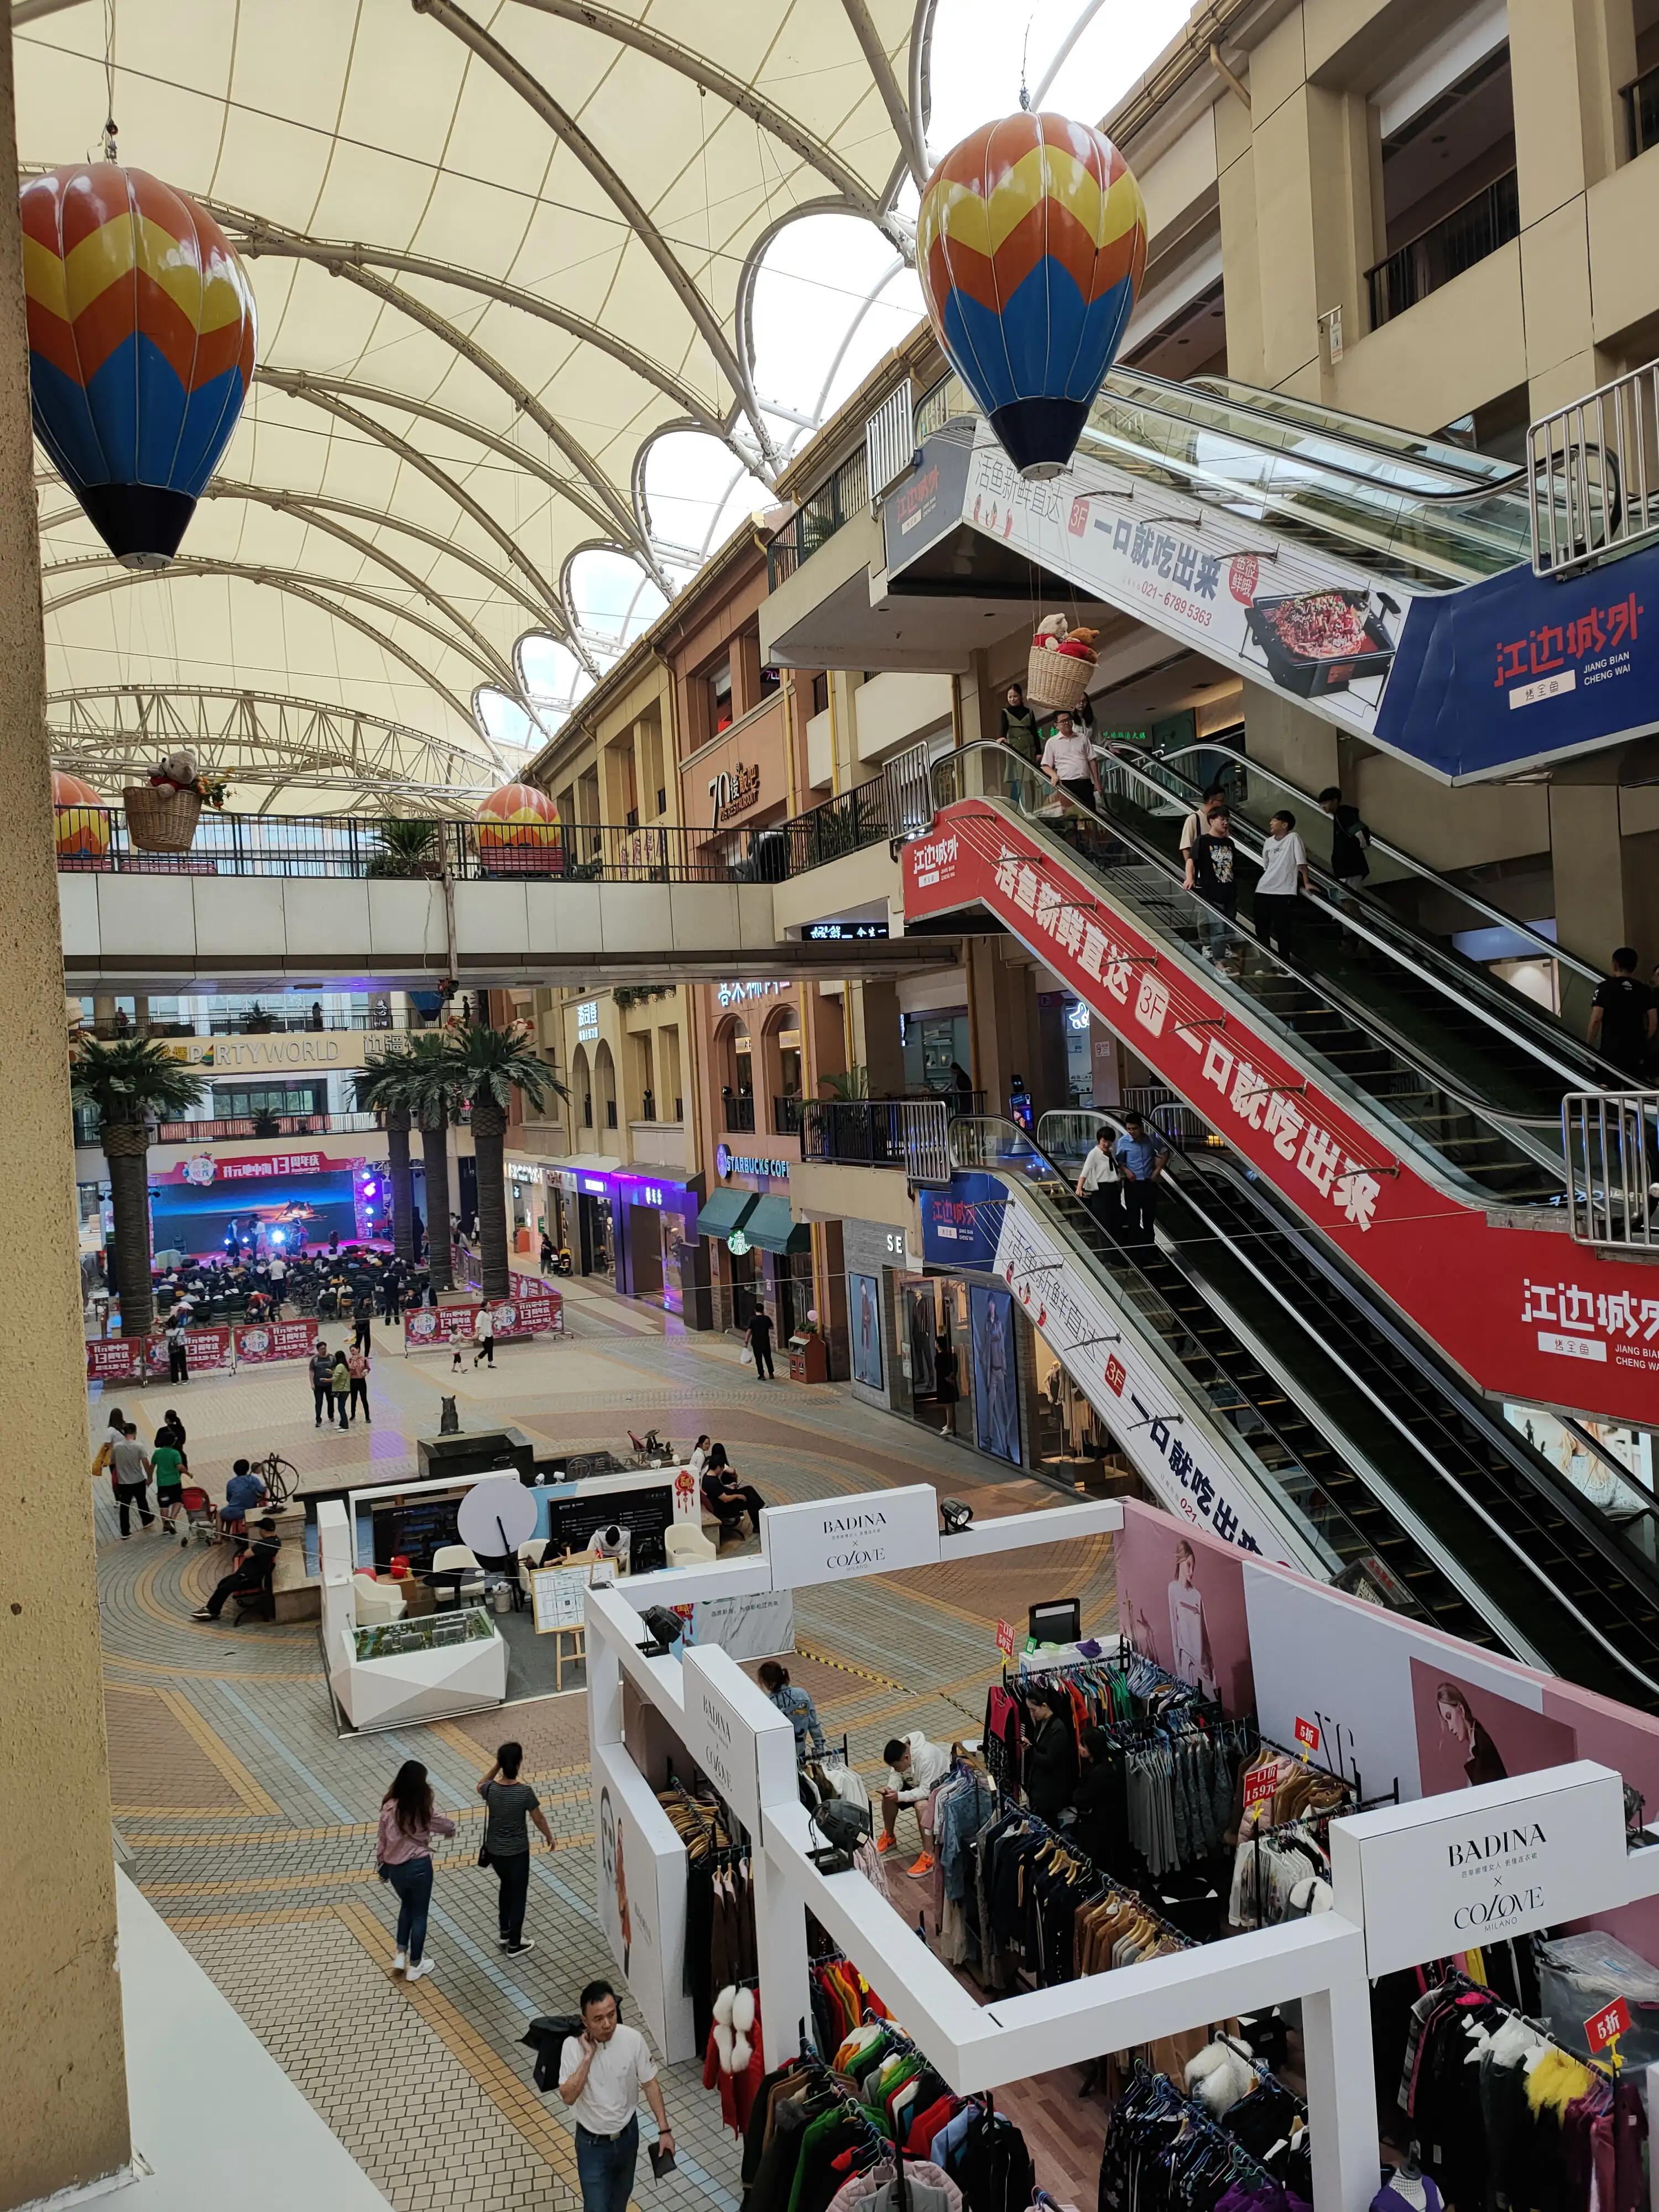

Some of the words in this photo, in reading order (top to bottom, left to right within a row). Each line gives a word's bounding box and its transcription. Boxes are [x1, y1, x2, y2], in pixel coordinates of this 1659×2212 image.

[1071, 504, 1088, 528] 3F
[1094, 518, 1222, 601] 一口就吃出来
[1494, 592, 1644, 687] 江边城外
[1583, 659, 1608, 674] JIANG
[1609, 651, 1630, 665] BIAN
[1584, 669, 1613, 686] CHENG
[1615, 664, 1631, 675] WAI
[914, 834, 958, 874] 江边城外
[995, 845, 1134, 1005] 活鱼新鲜直达
[1139, 985, 1166, 1020] 3F
[1174, 1020, 1381, 1232] 一口就吃出来
[727, 1155, 769, 1175] STARBUCKS
[1009, 1224, 1099, 1364] 活鱼新鲜直达
[1615, 1344, 1640, 1355] JIANG
[1106, 1360, 1125, 1387] 3F
[1616, 1357, 1646, 1369] CHENG
[823, 1513, 886, 1533] BADINA
[827, 1548, 886, 1569] COLOVE
[999, 1623, 1014, 1640] 一口价
[998, 1635, 1011, 1652] 50元
[703, 1694, 731, 1743] BADINA
[1300, 1725, 1314, 1744] 5折
[1247, 1766, 1277, 1783] 一口价
[1245, 1780, 1277, 1802] 159元
[1447, 1824, 1547, 1867] BADINA
[1454, 1886, 1545, 1929] COLOVE
[1484, 1916, 1518, 1933] MILANO
[1597, 2009, 1620, 2039] 5折
